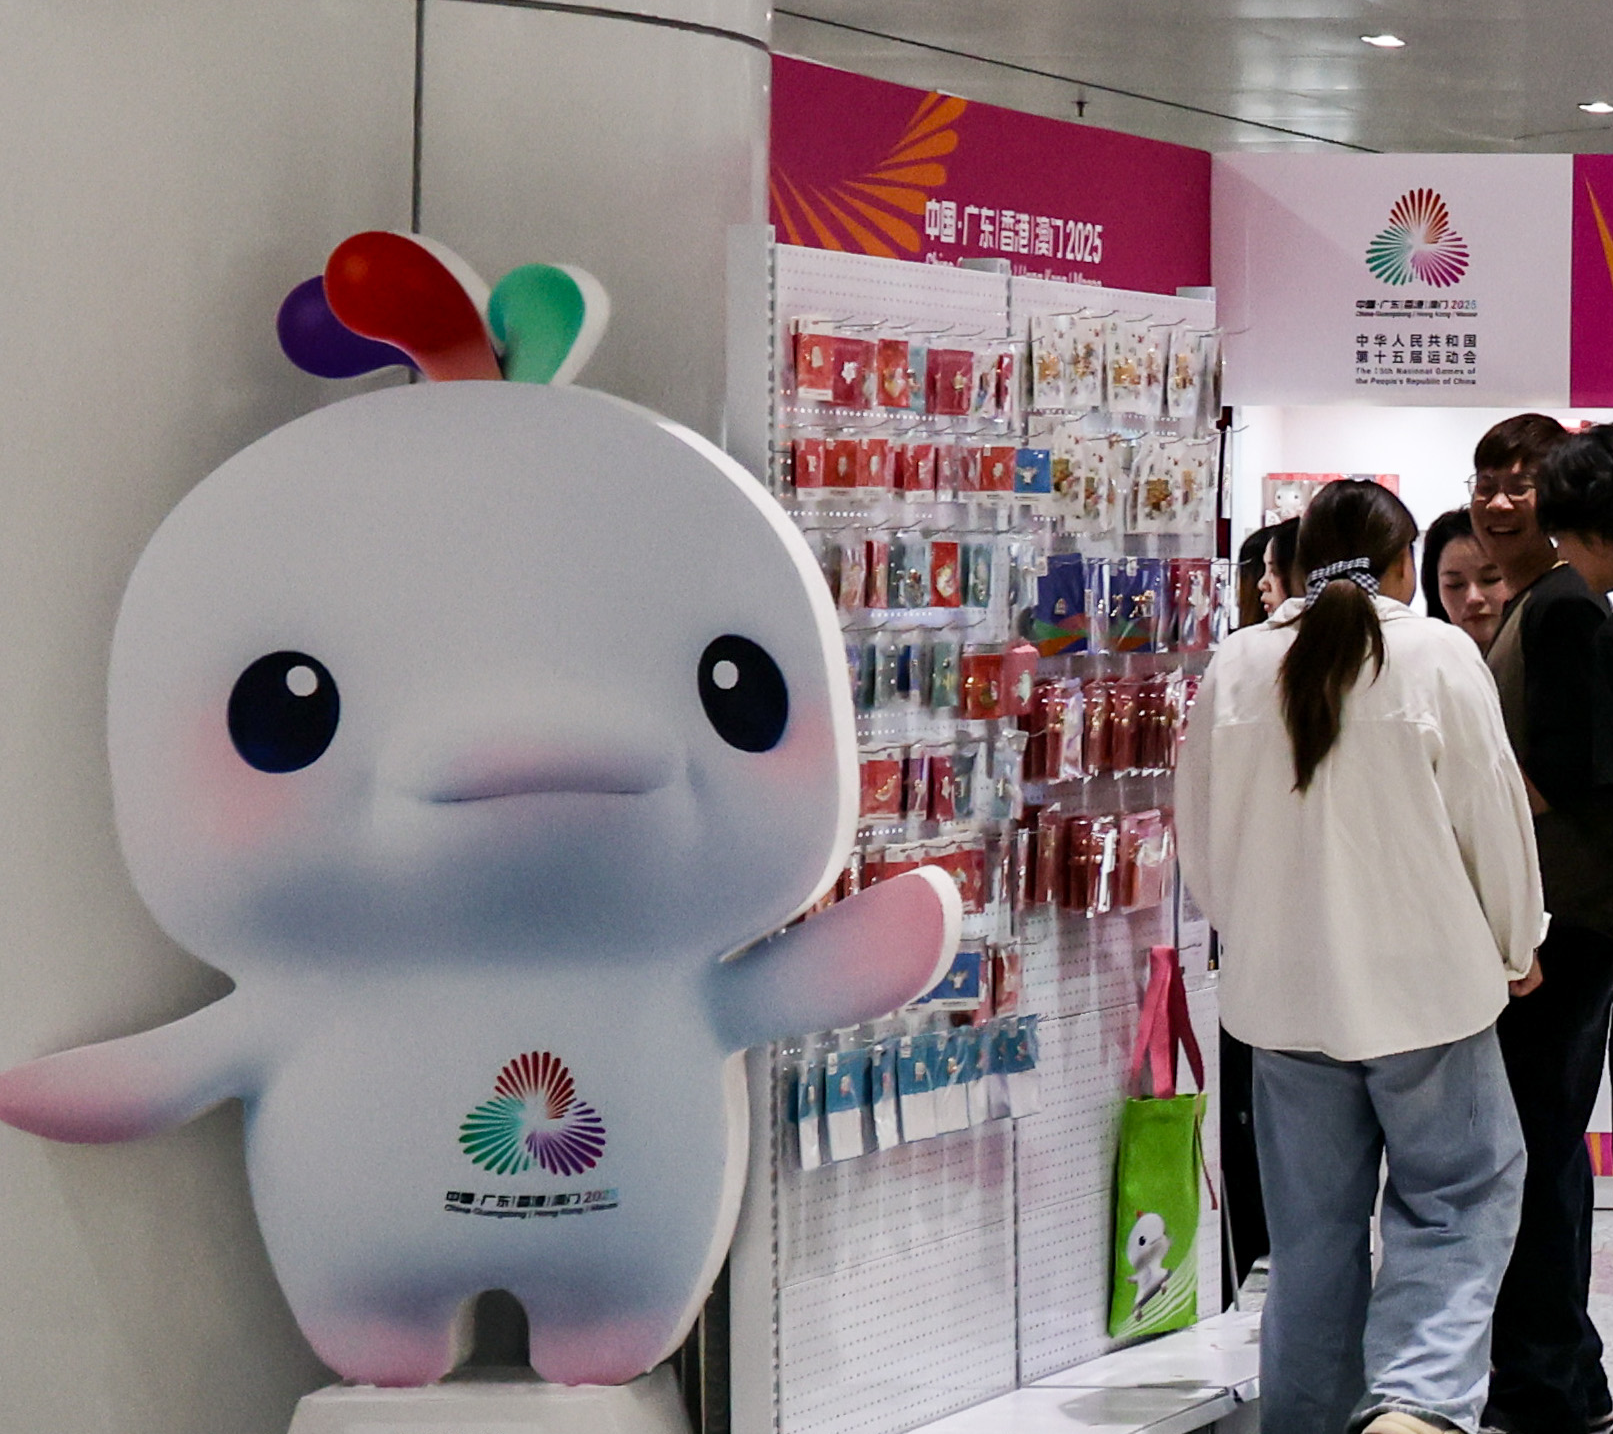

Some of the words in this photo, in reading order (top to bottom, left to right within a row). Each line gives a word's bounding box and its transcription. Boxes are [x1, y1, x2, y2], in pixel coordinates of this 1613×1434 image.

[1065, 220, 1103, 264] 2025
[1356, 333, 1477, 347] 中华人民共和国
[1355, 350, 1476, 364] 第十五届运动会
